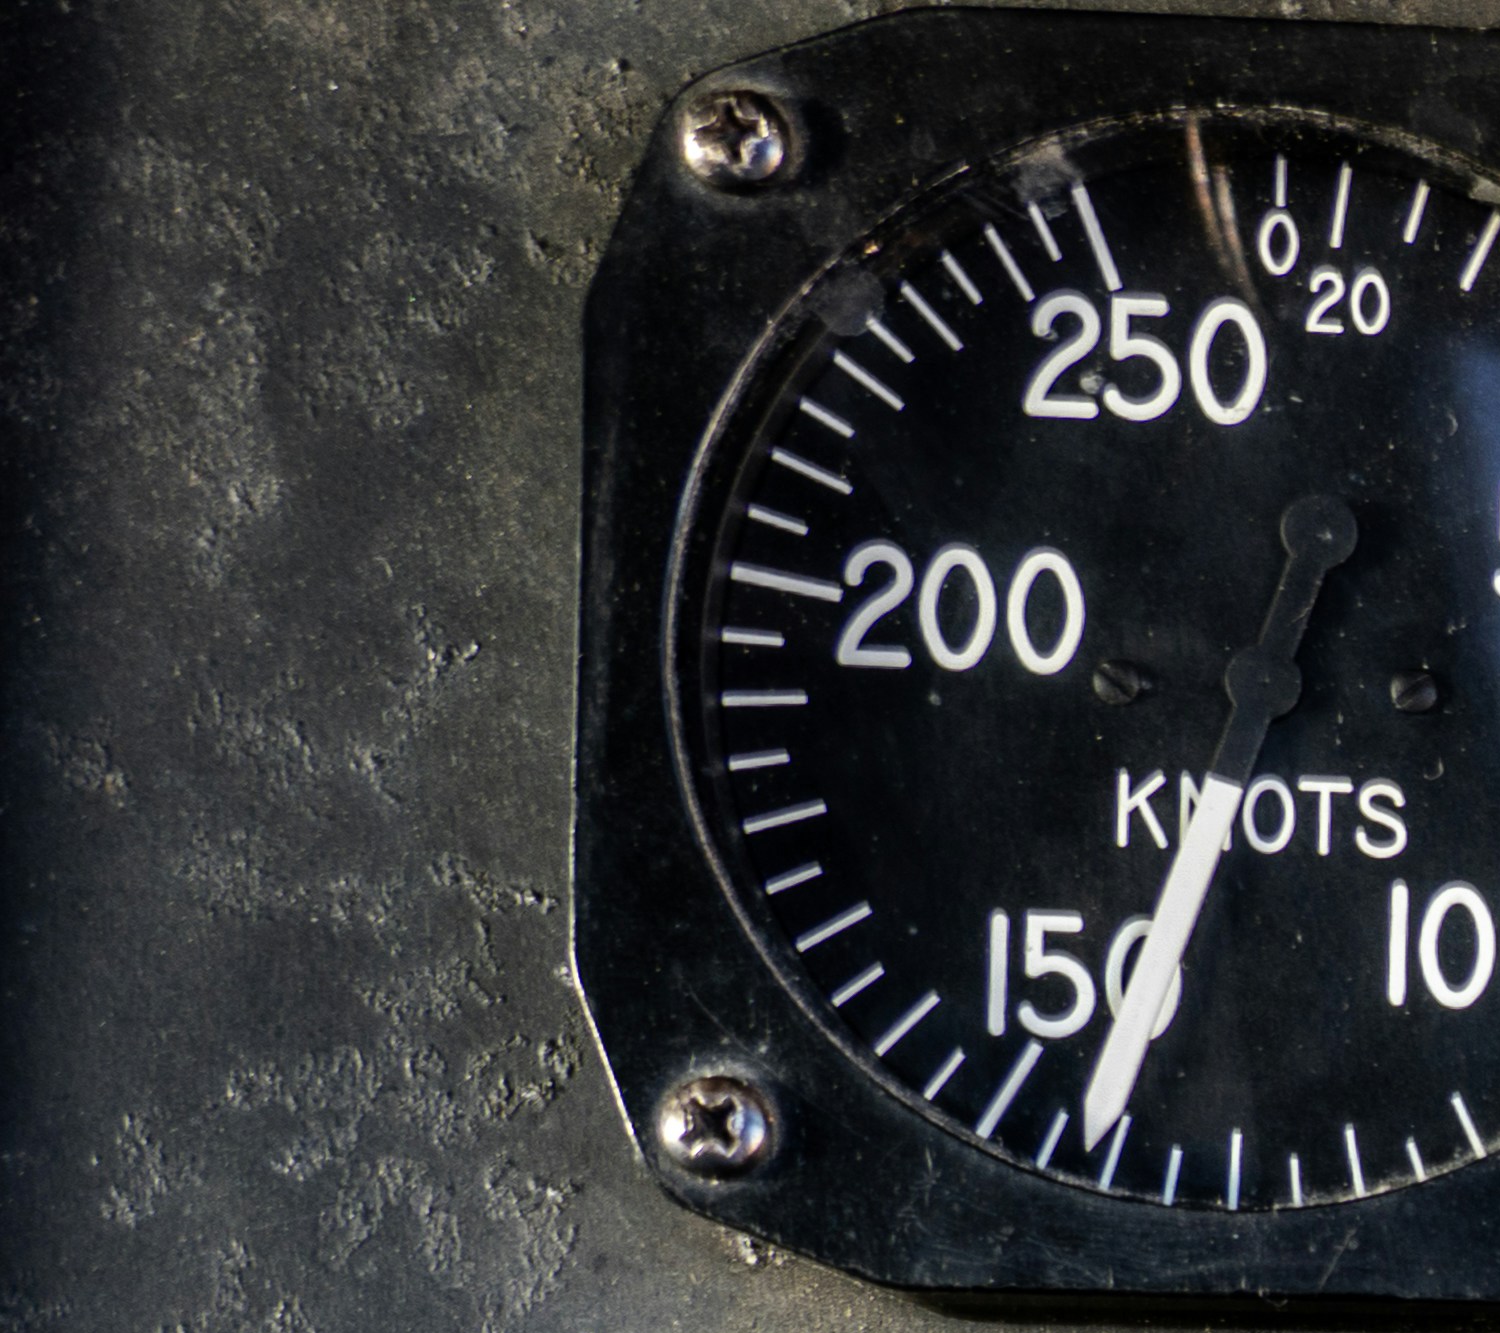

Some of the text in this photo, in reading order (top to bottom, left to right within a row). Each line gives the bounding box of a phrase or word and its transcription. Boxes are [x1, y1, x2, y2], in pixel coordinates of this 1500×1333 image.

[1258, 210, 1298, 276] 0
[1306, 272, 1390, 335] 20
[1025, 293, 1268, 425] 250
[837, 544, 1085, 674] 200
[989, 910, 1181, 1041] 150
